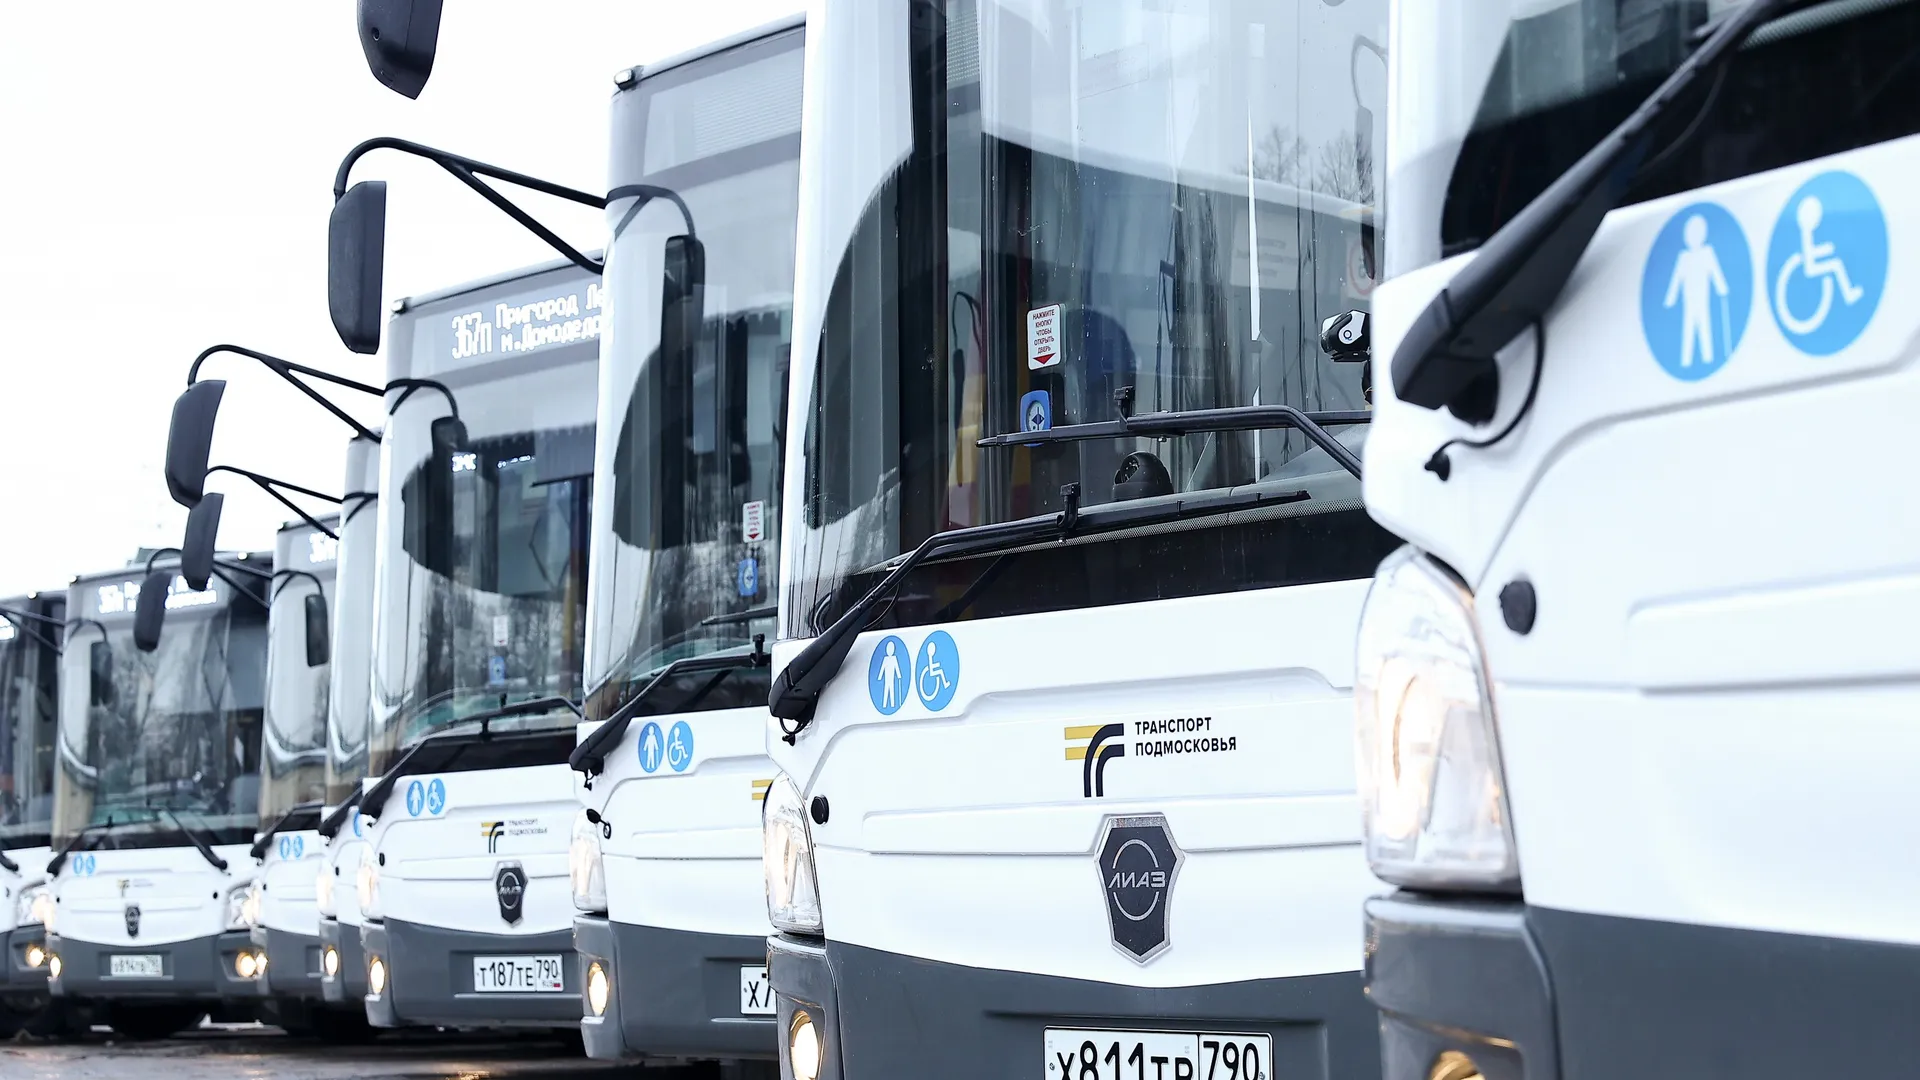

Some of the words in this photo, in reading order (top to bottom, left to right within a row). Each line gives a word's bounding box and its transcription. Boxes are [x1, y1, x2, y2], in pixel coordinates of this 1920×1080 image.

[496, 294, 579, 330] Пригород
[1033, 309, 1055, 320] НАЖМИТЕ
[1035, 319, 1052, 328] КНОПКУ
[1036, 328, 1052, 337] ЧТОБЫ
[1034, 336, 1055, 346] ОТКРЫТЬ
[1038, 346, 1051, 354] ДВЕРЬ
[1135, 717, 1212, 736] ТРАНСПОРТ
[1135, 736, 1237, 758] ПОДМОСКОВЬЯ
[1108, 871, 1167, 889] ЛИАЗ
[479, 961, 534, 988] Т187ТЕ
[536, 959, 559, 980] 790
[1202, 1040, 1260, 1080] 790
